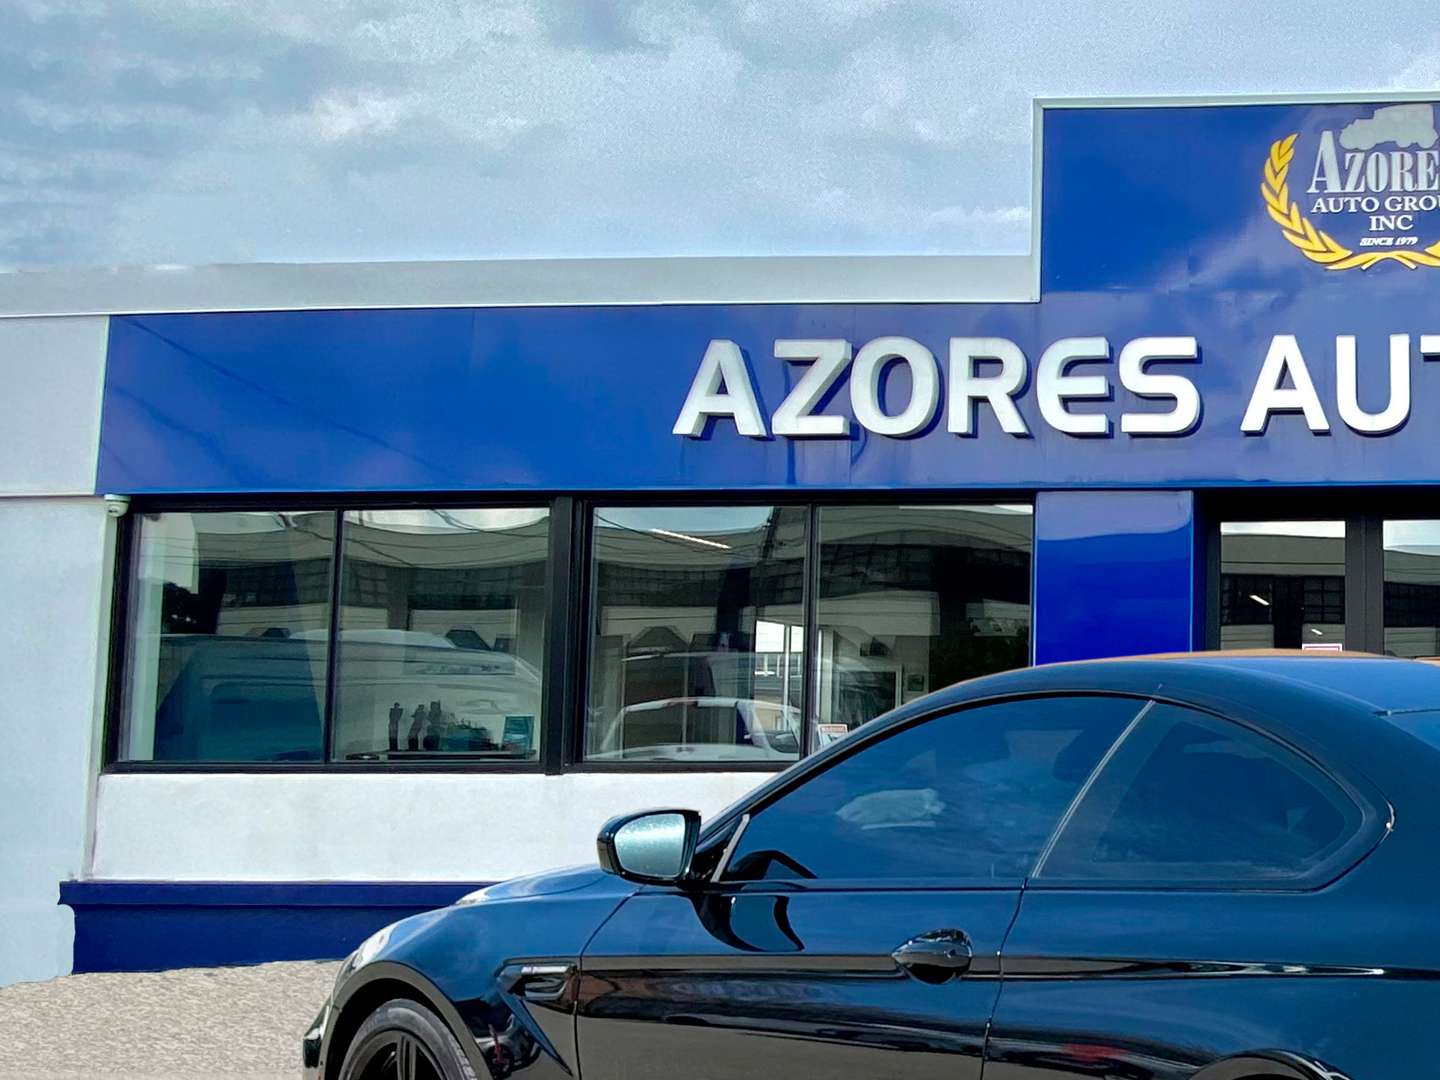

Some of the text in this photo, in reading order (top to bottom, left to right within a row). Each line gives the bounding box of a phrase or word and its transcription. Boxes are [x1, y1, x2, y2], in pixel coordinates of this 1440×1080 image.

[1311, 196, 1380, 213] AUTO
[1369, 215, 1414, 231] INC
[1359, 237, 1394, 246] SINCE
[671, 336, 1202, 438] AZORES
